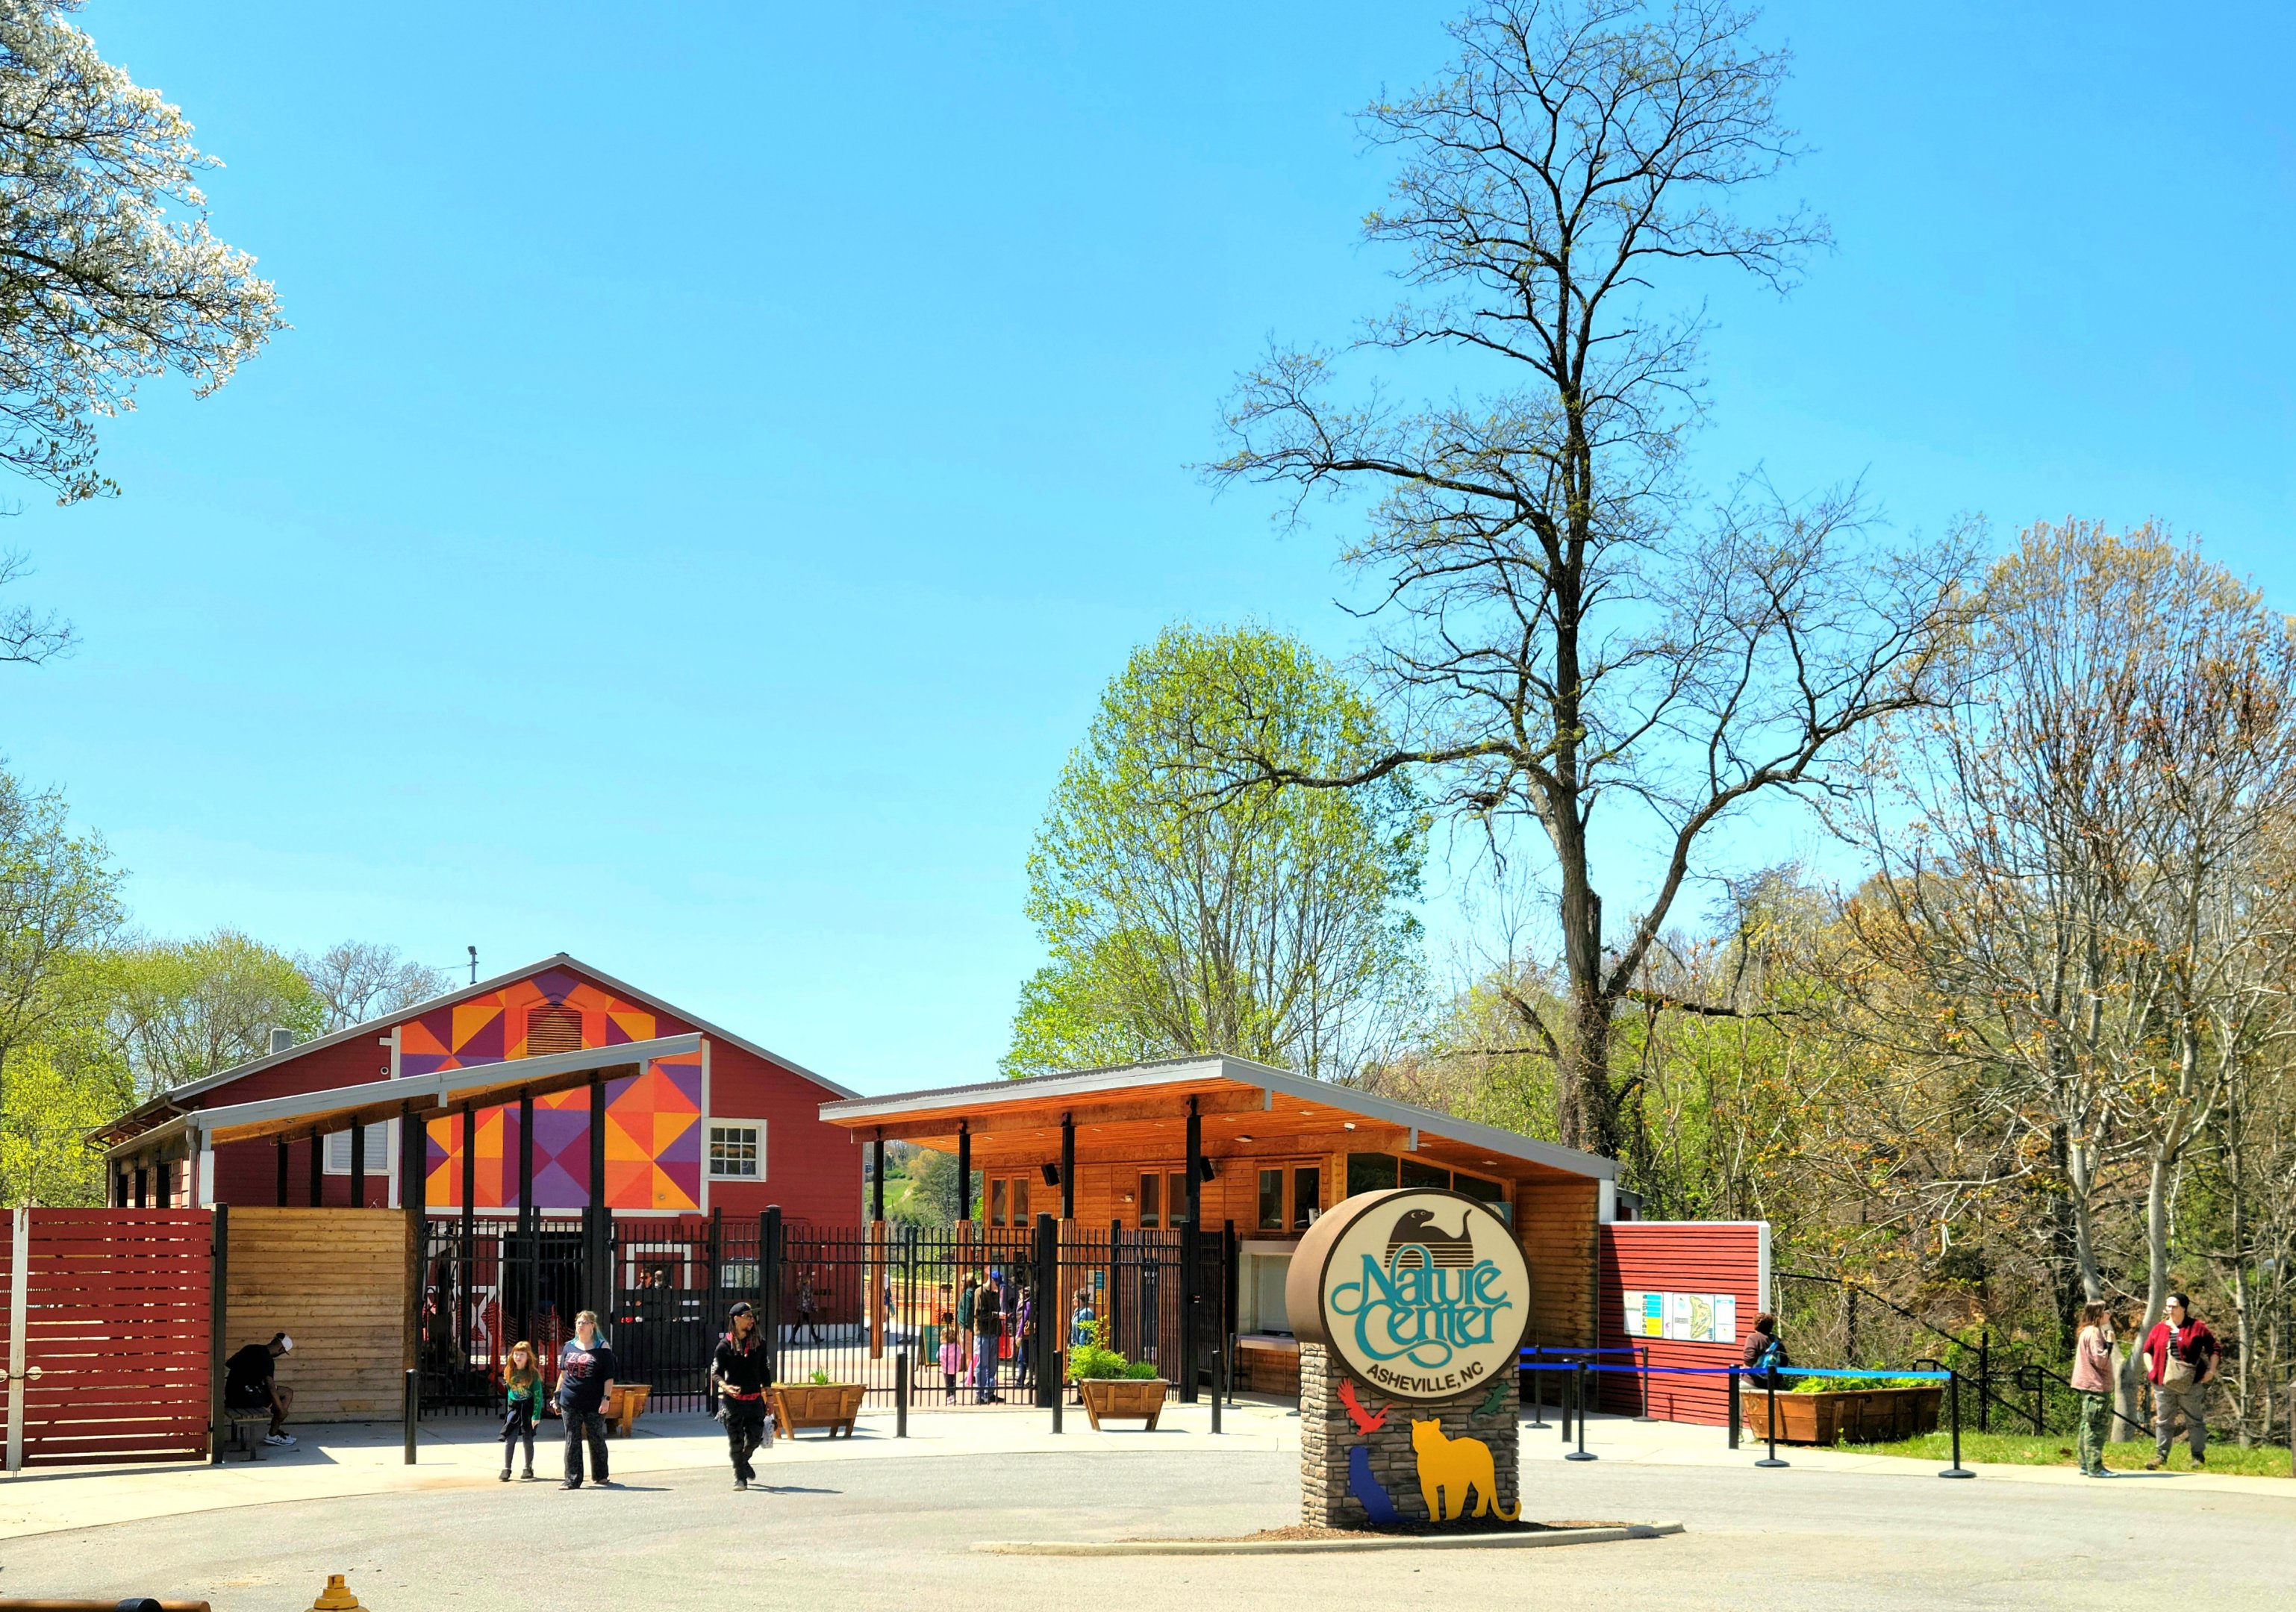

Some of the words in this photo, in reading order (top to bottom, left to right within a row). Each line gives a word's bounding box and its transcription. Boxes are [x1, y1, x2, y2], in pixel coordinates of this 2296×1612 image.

[1331, 1244, 1508, 1315] Nature
[1355, 1301, 1512, 1369] Center
[1367, 1363, 1461, 1393] ASHEVILLE,
[1460, 1360, 1484, 1383] NC
